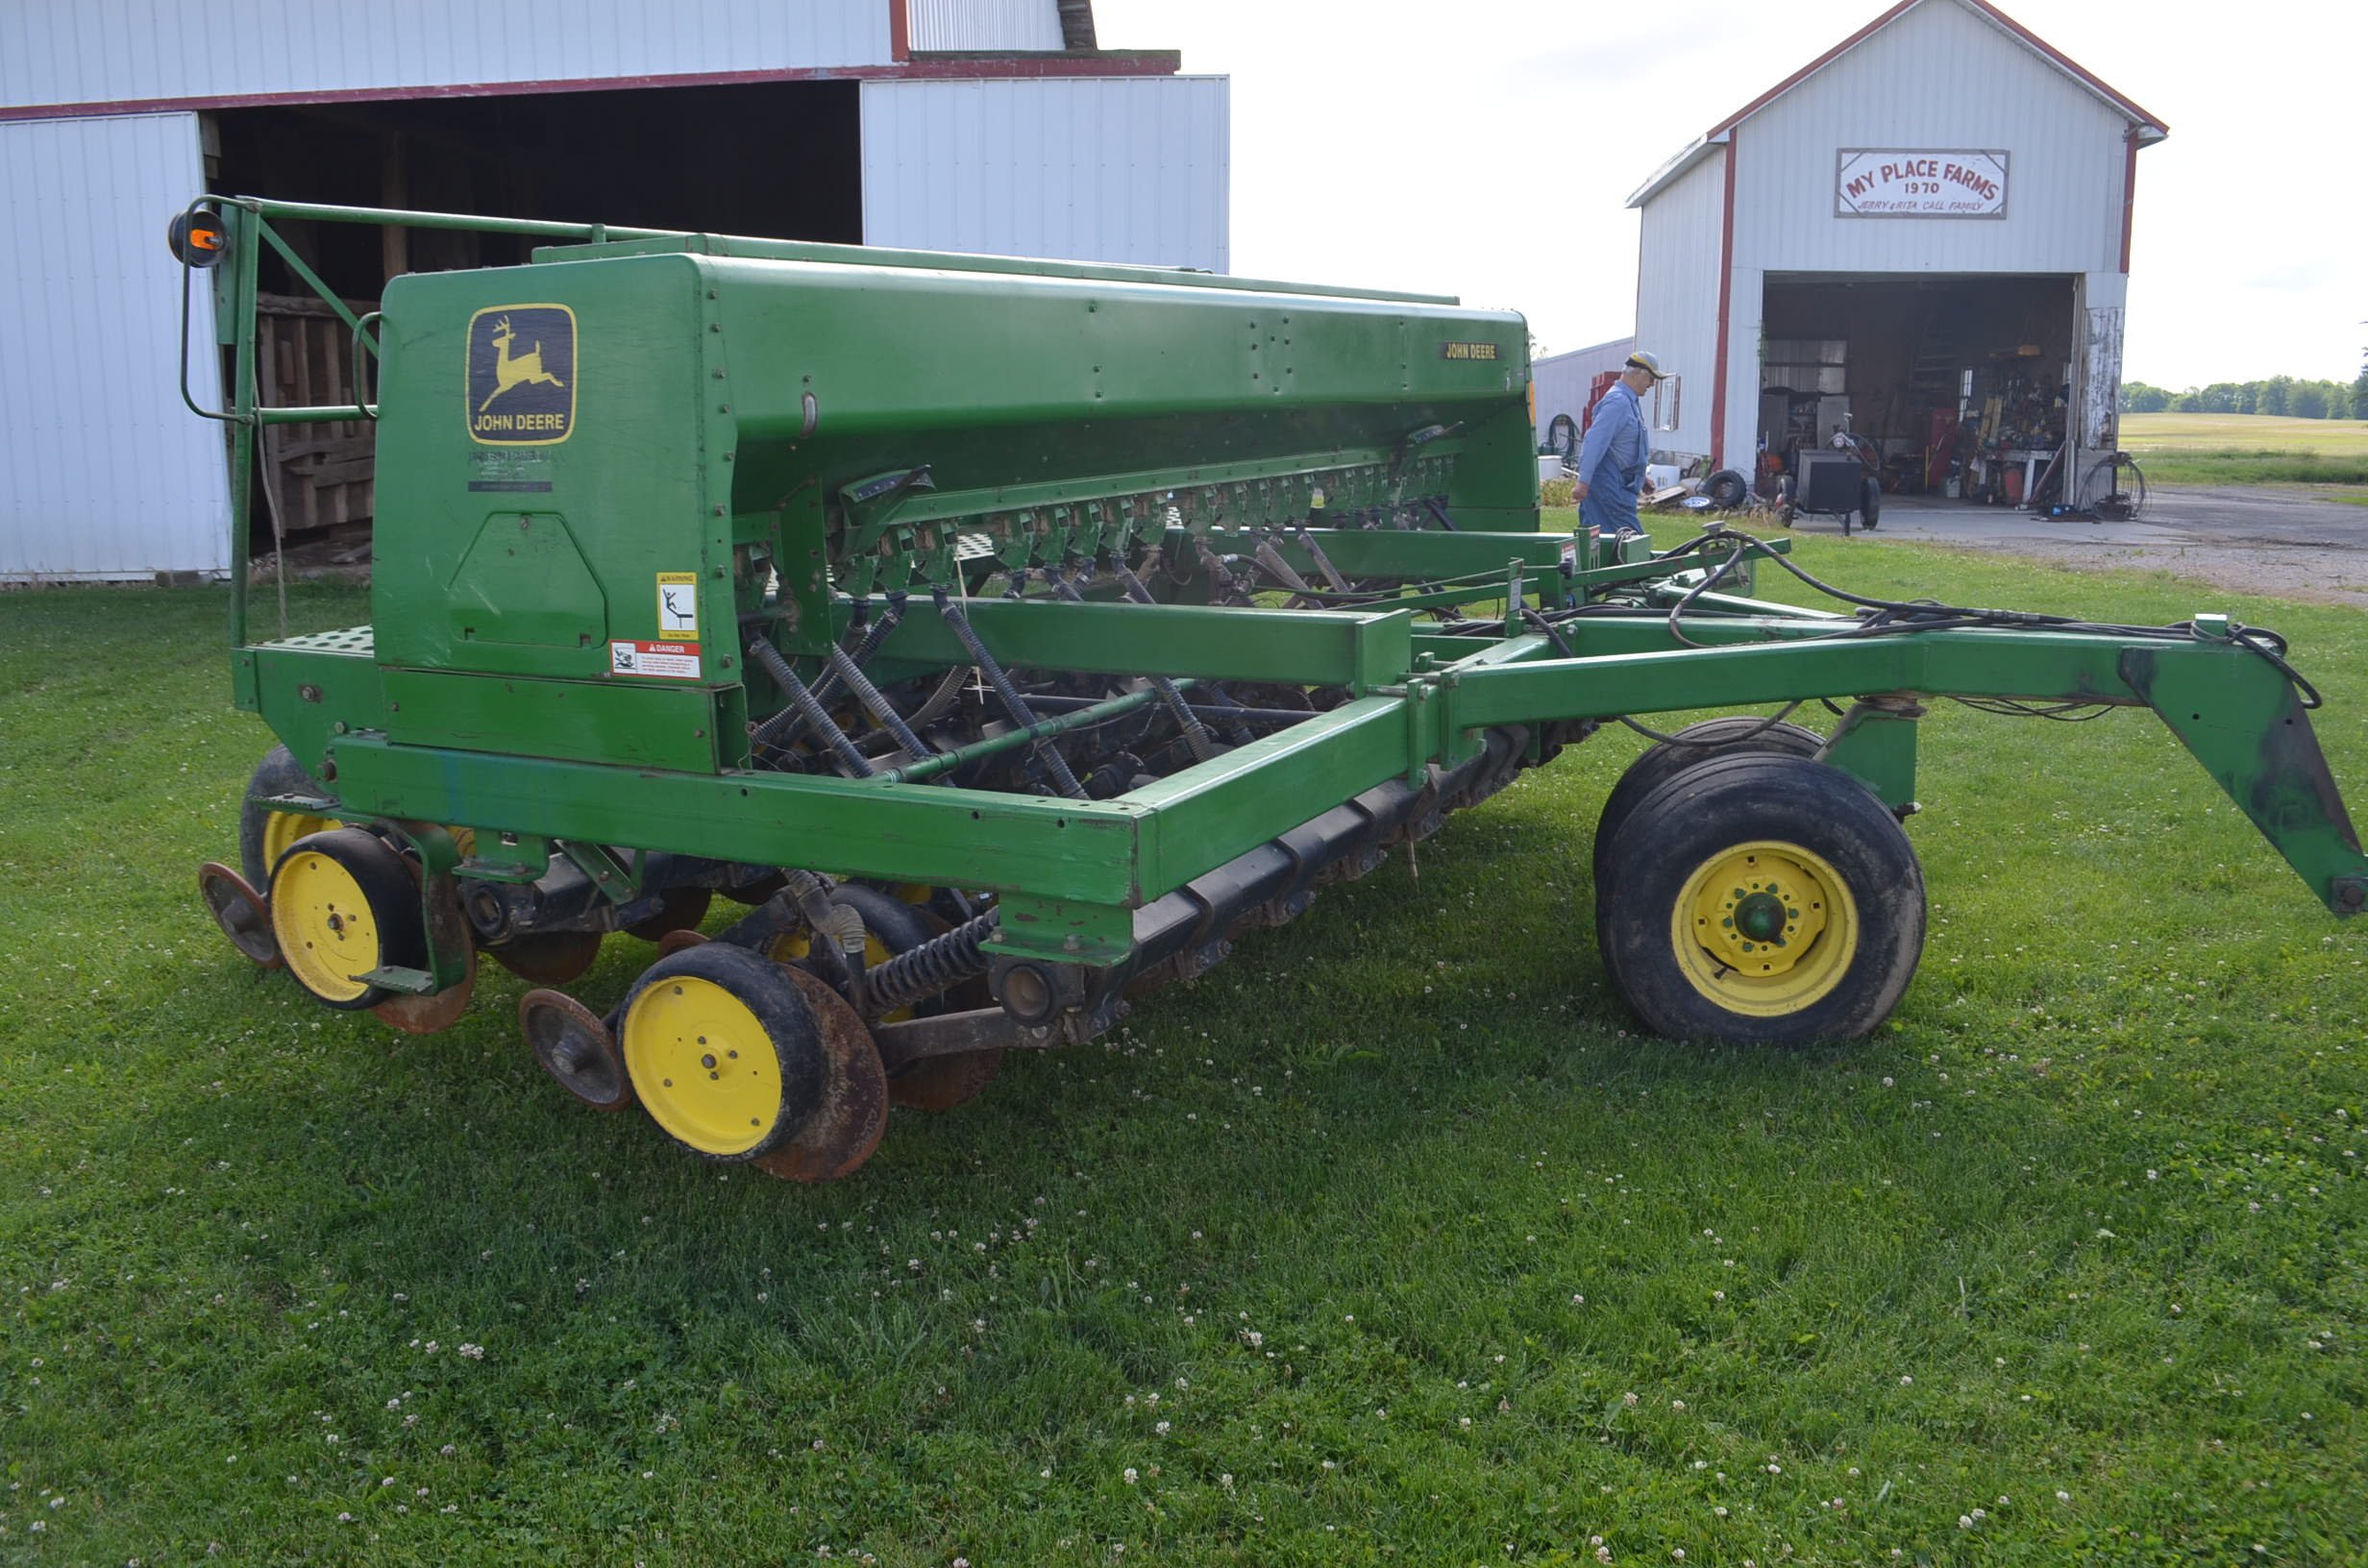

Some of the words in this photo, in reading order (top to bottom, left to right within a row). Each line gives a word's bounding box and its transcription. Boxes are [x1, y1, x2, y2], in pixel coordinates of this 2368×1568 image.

[1846, 171, 1875, 199] MY
[1880, 159, 1938, 183] PLACE
[1943, 163, 1999, 201] FARMS
[1905, 183, 1939, 194] 1970
[1949, 201, 1984, 210] FAMILY
[1446, 343, 1468, 358] JOHN
[1470, 344, 1495, 359] DEERE
[475, 415, 512, 431] JOHN
[516, 414, 565, 430] DEERE
[655, 644, 685, 653] DANGER
